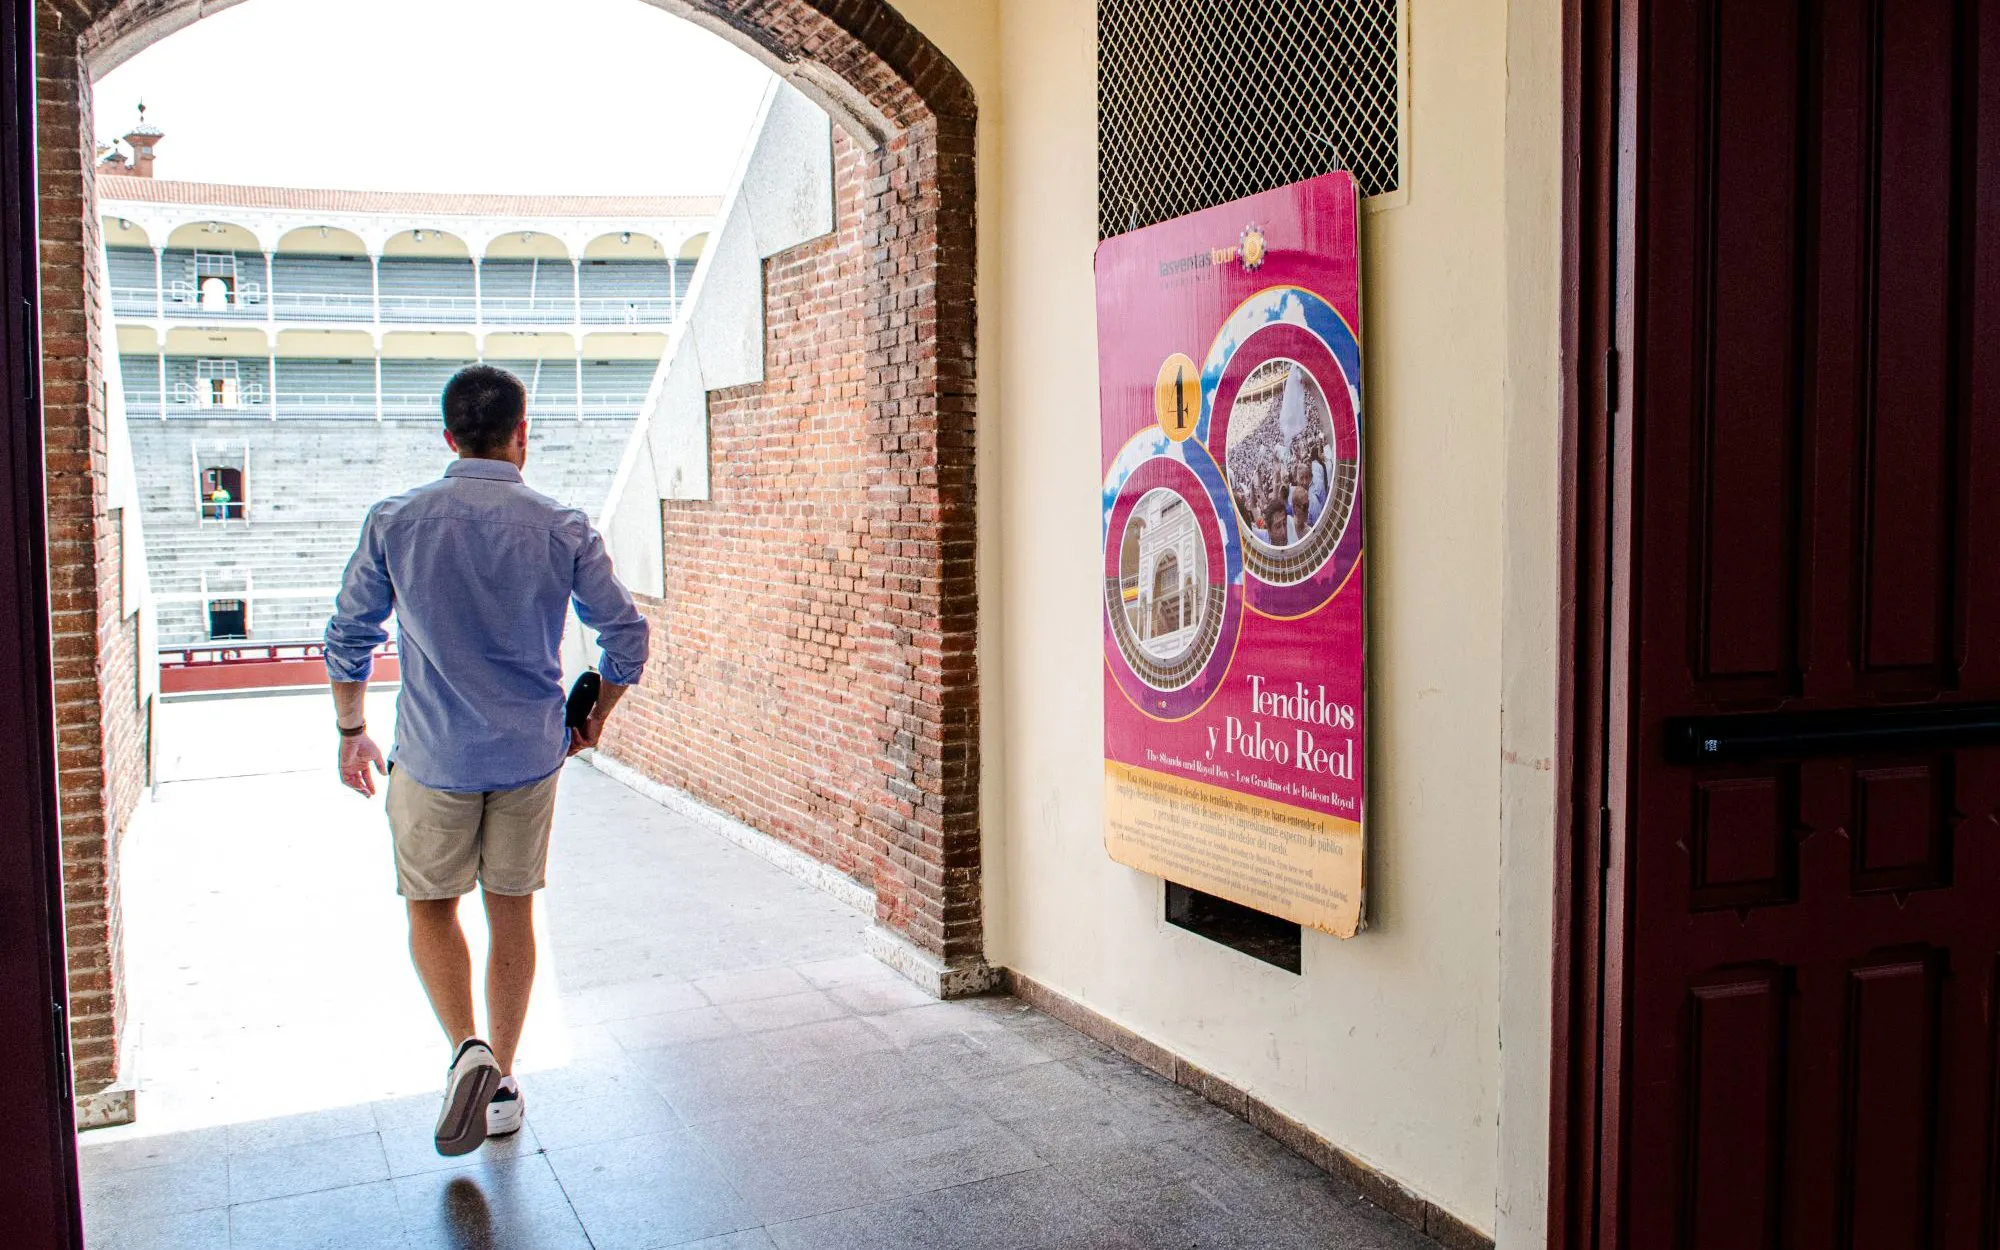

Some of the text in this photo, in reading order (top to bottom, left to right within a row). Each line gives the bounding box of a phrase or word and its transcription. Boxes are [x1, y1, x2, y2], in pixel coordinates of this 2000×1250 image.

[1167, 365, 1189, 429] 4
[1247, 675, 1354, 730] Tendidos
[1205, 716, 1354, 780] y Palco Real
[1145, 749, 1158, 761] The
[1160, 753, 1181, 768] Stands
[1183, 759, 1195, 771] and
[1197, 760, 1214, 776] Royal
[1216, 765, 1229, 779] Box
[1251, 773, 1281, 791] Gradins
[1282, 782, 1291, 794] et
[1292, 783, 1300, 796] le
[1331, 792, 1354, 810] Royal
[1318, 821, 1324, 834] el
